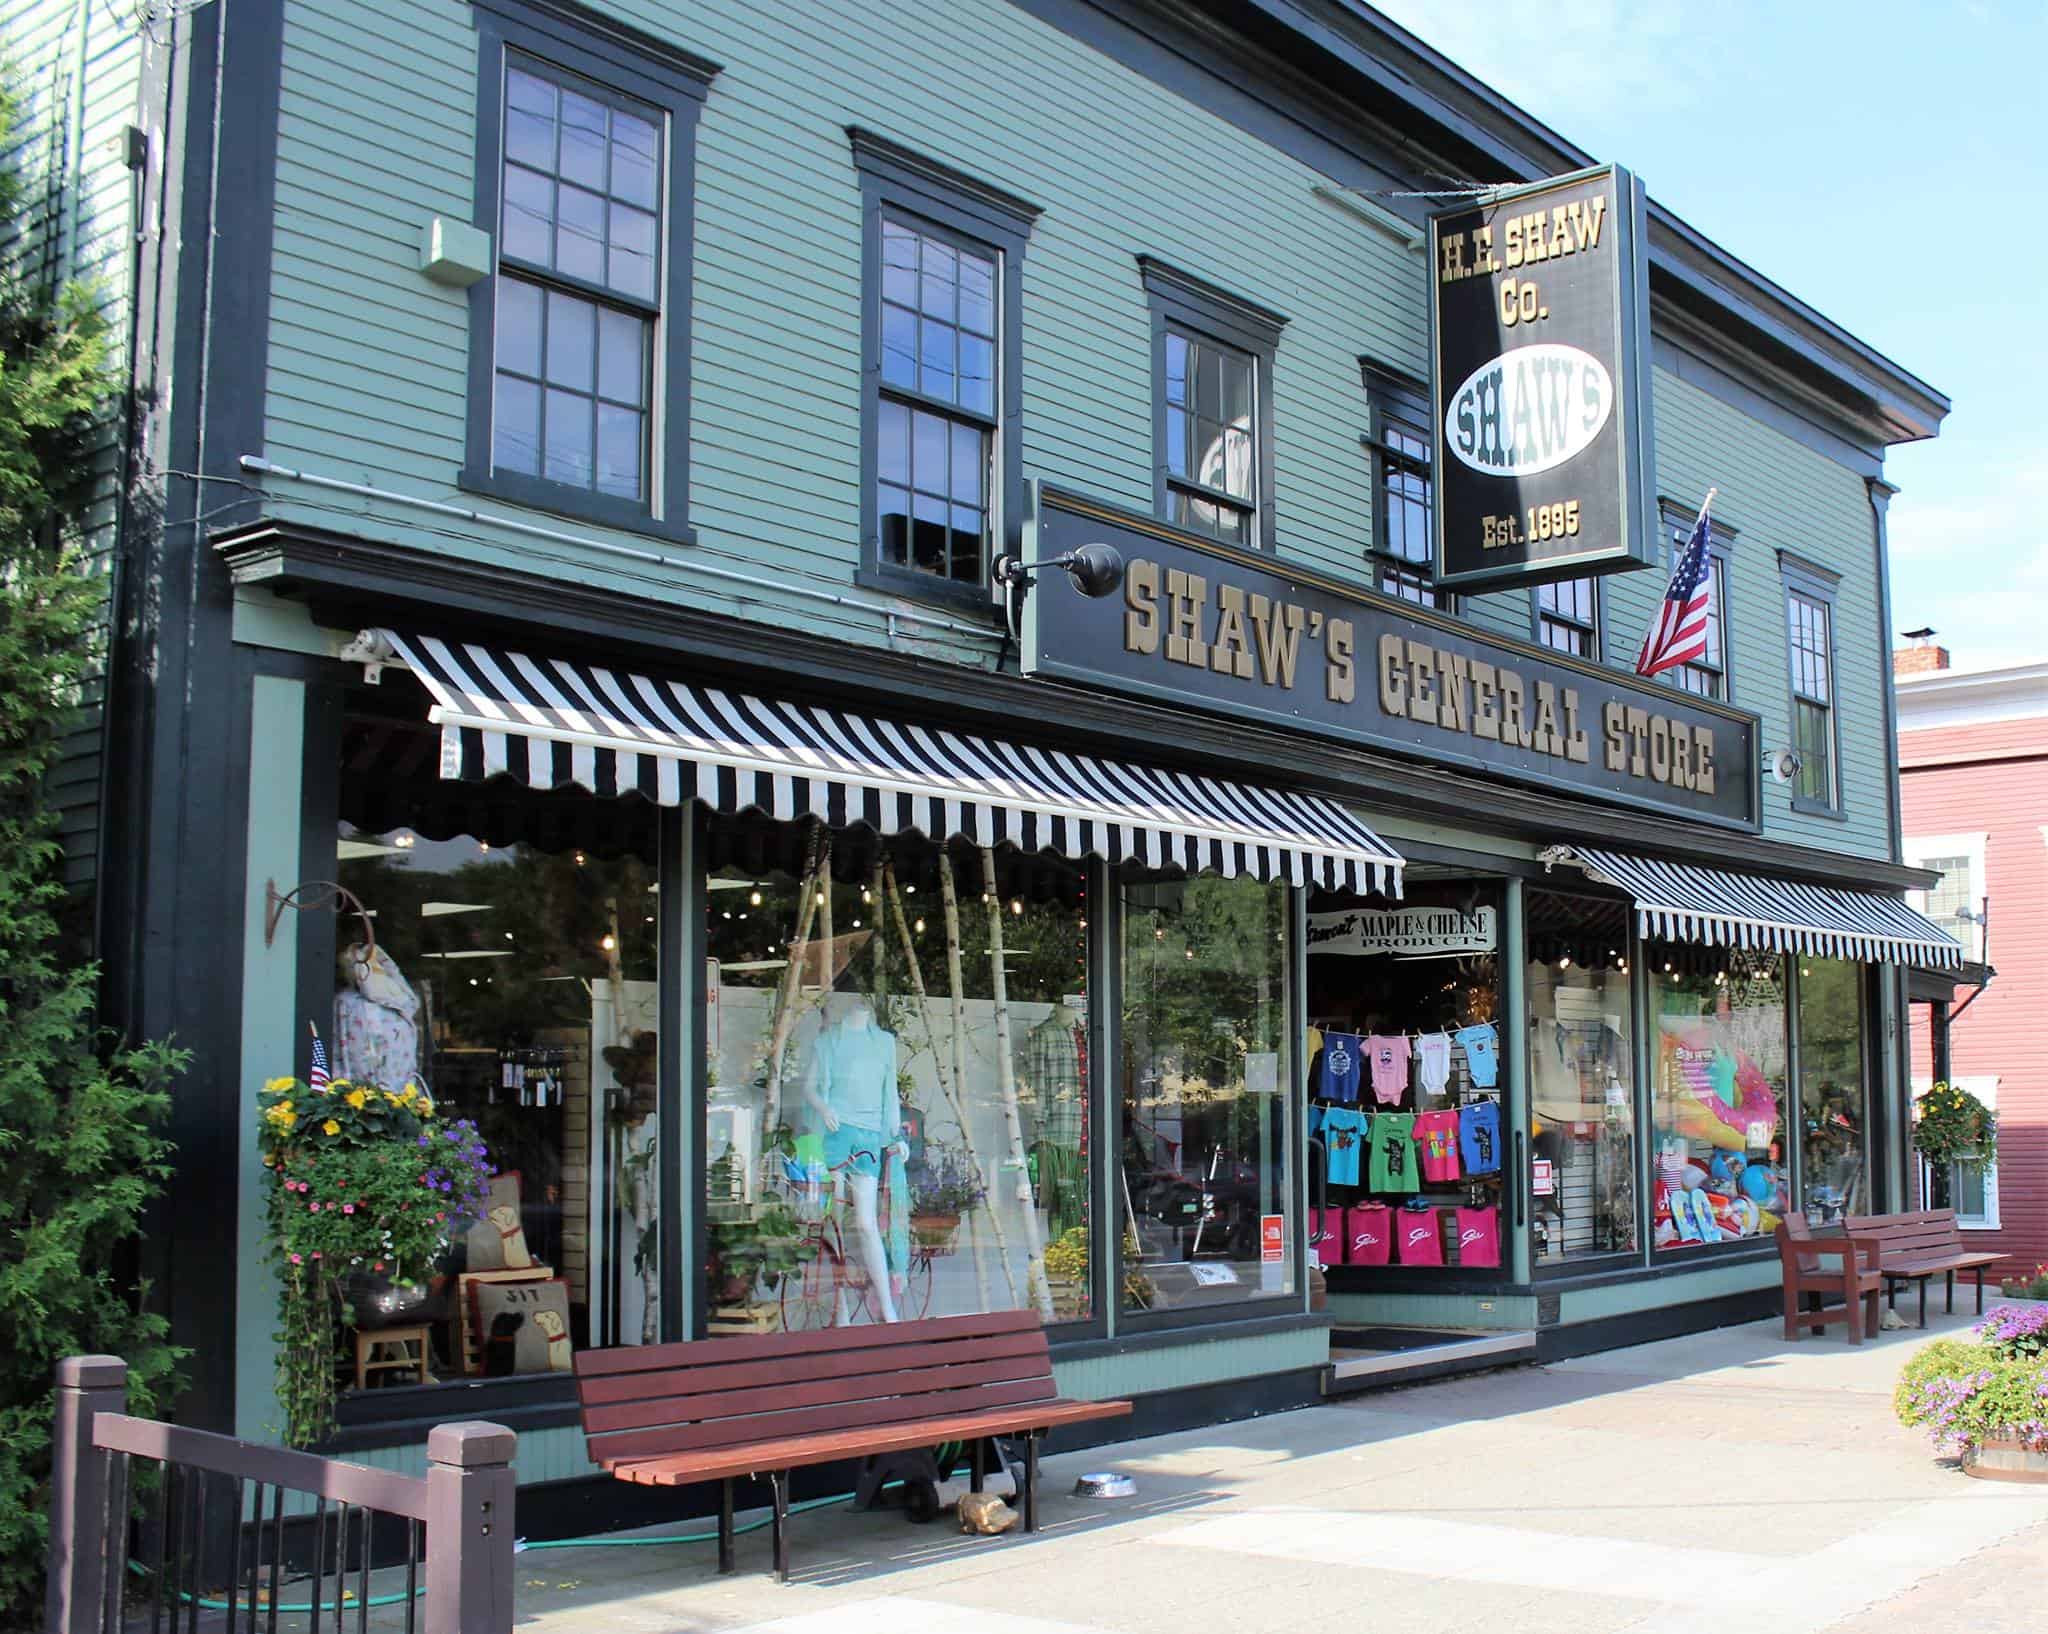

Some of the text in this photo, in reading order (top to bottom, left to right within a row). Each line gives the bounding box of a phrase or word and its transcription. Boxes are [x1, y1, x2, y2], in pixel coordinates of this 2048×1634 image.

[1505, 195, 1606, 268] SHAW
[1482, 500, 1580, 549] Est. 1895
[1125, 558, 1715, 795] SHAW'S GENERAL STORE
[1361, 914, 1413, 936] MAPLE
[1416, 915, 1425, 934] &
[1427, 913, 1488, 935] CHEESE
[1362, 935, 1487, 948] PRODUCTS
